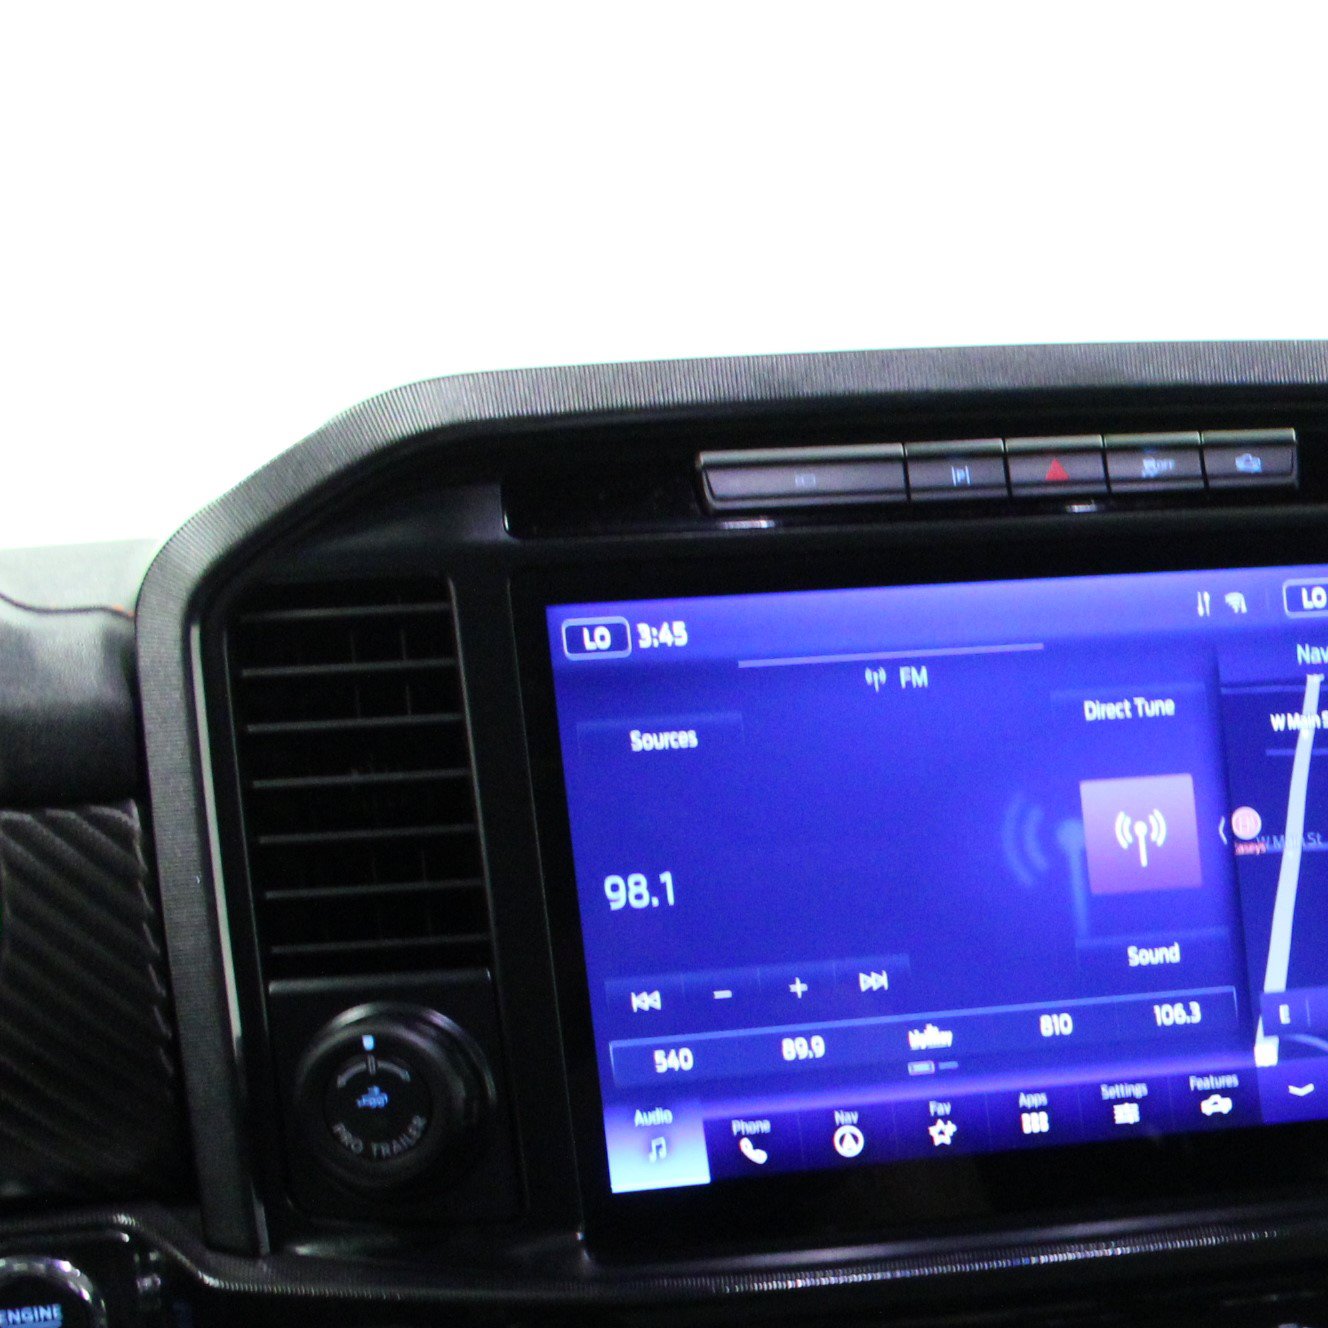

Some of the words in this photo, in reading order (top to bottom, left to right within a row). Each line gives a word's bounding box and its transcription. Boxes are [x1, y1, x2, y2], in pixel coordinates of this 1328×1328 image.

[1302, 587, 1327, 609] LO
[582, 626, 612, 651] LO
[637, 621, 689, 649] 3:45
[899, 666, 929, 688] FM
[1084, 699, 1132, 721] Direct
[1135, 696, 1176, 718] Tune
[1270, 713, 1286, 732] W
[1287, 712, 1321, 730] Main
[629, 729, 698, 752] Sources
[604, 871, 676, 911] 98.1
[1128, 942, 1181, 967] Sound
[1041, 1013, 1073, 1037] 810
[1153, 1002, 1202, 1027] 106.3
[782, 1036, 825, 1061] 89.9
[654, 1048, 694, 1073] 540
[1101, 1081, 1148, 1100] Settings
[1189, 1072, 1239, 1092] Features
[929, 1101, 951, 1118] Fav
[1019, 1091, 1048, 1108] Apps
[634, 1107, 673, 1127] Audio
[732, 1118, 771, 1136] Phone
[834, 1109, 859, 1126] Nav
